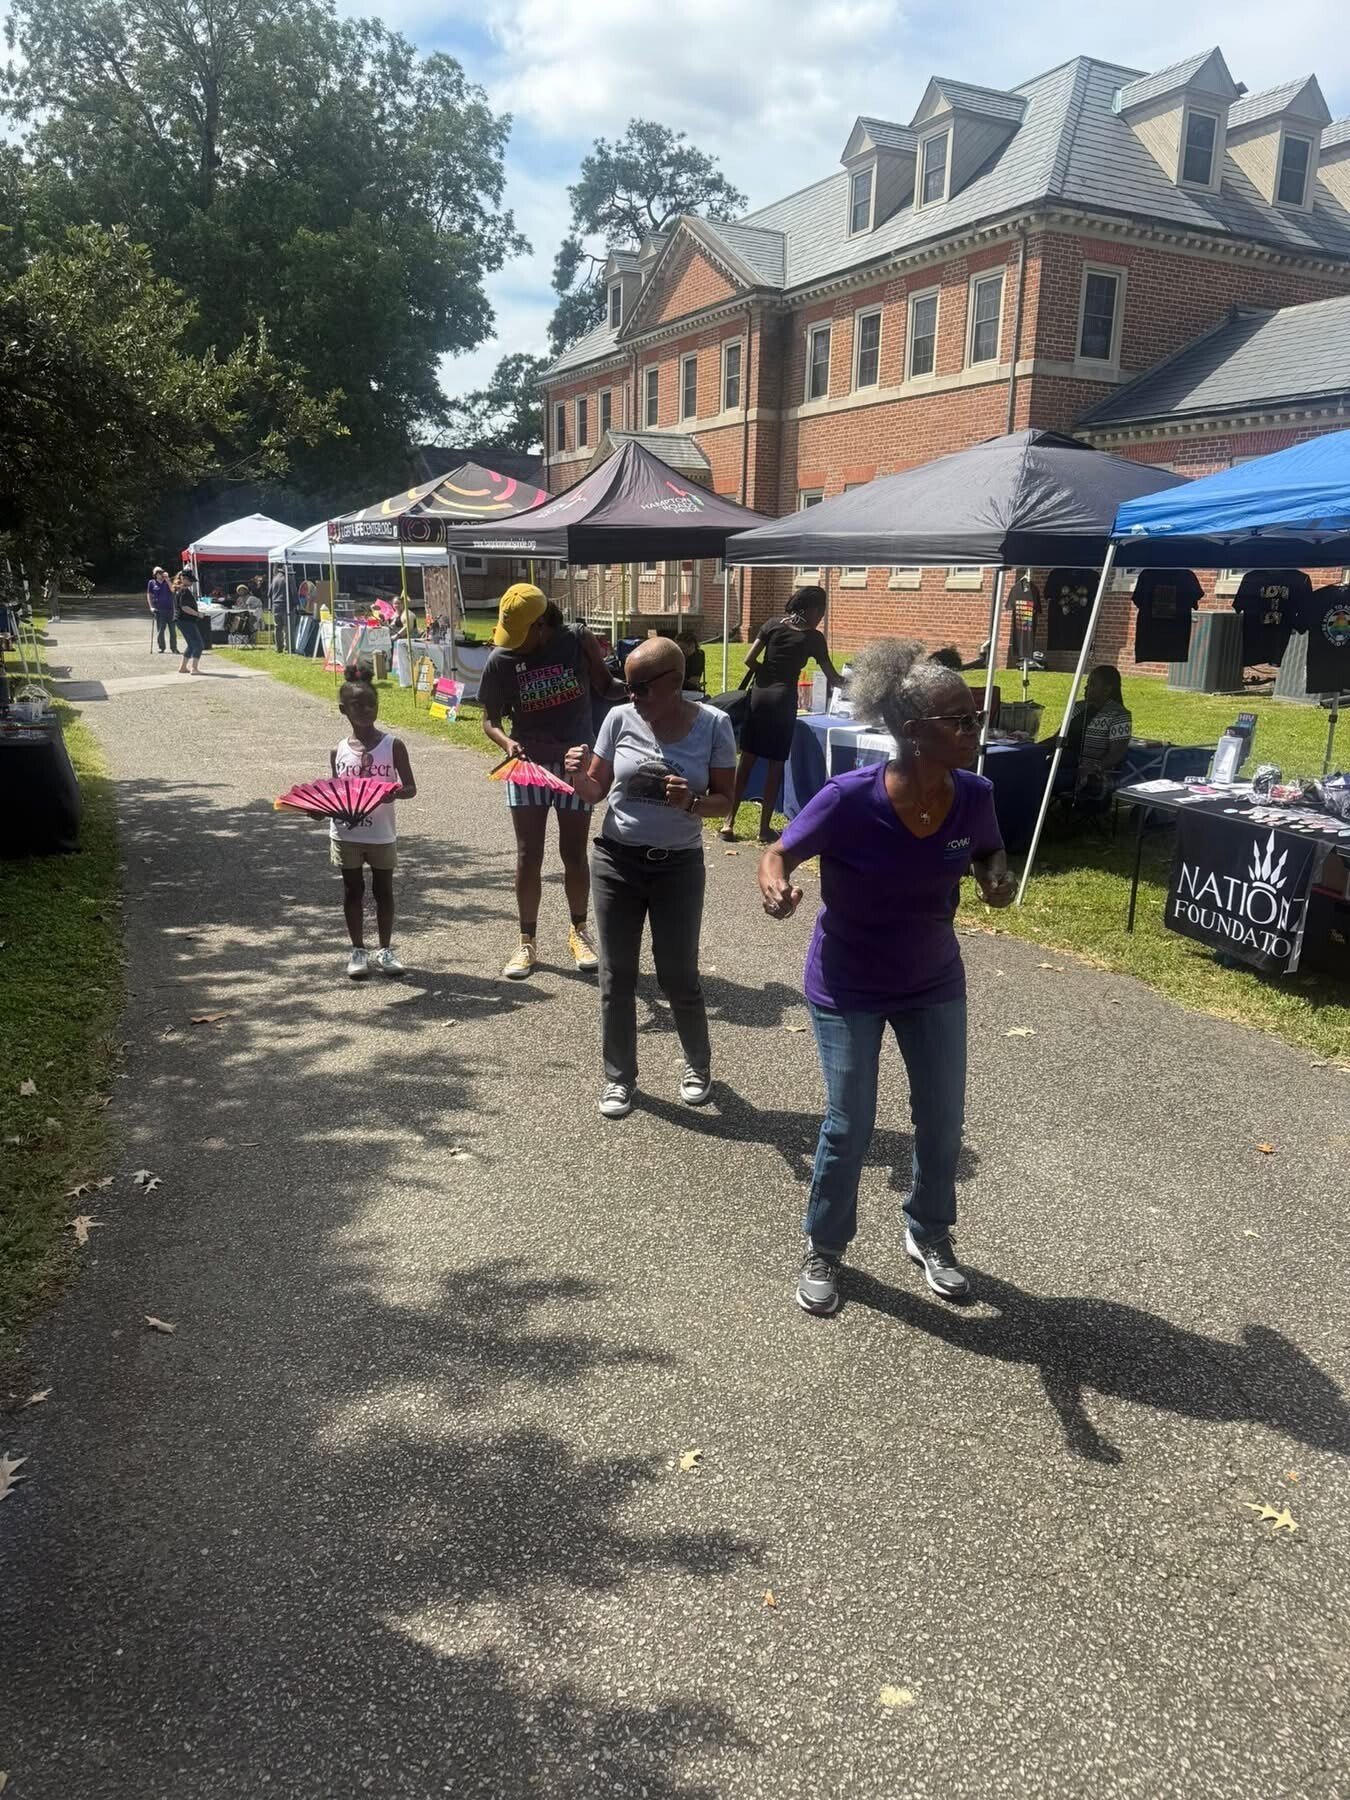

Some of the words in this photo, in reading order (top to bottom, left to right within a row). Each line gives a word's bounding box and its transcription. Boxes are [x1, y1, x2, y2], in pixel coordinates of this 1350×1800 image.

[519, 666, 562, 683] RESPECT
[521, 691, 538, 702] OR
[538, 679, 578, 699] EXPECT
[522, 685, 585, 712] RESISTANCE
[337, 762, 392, 777] Proect
